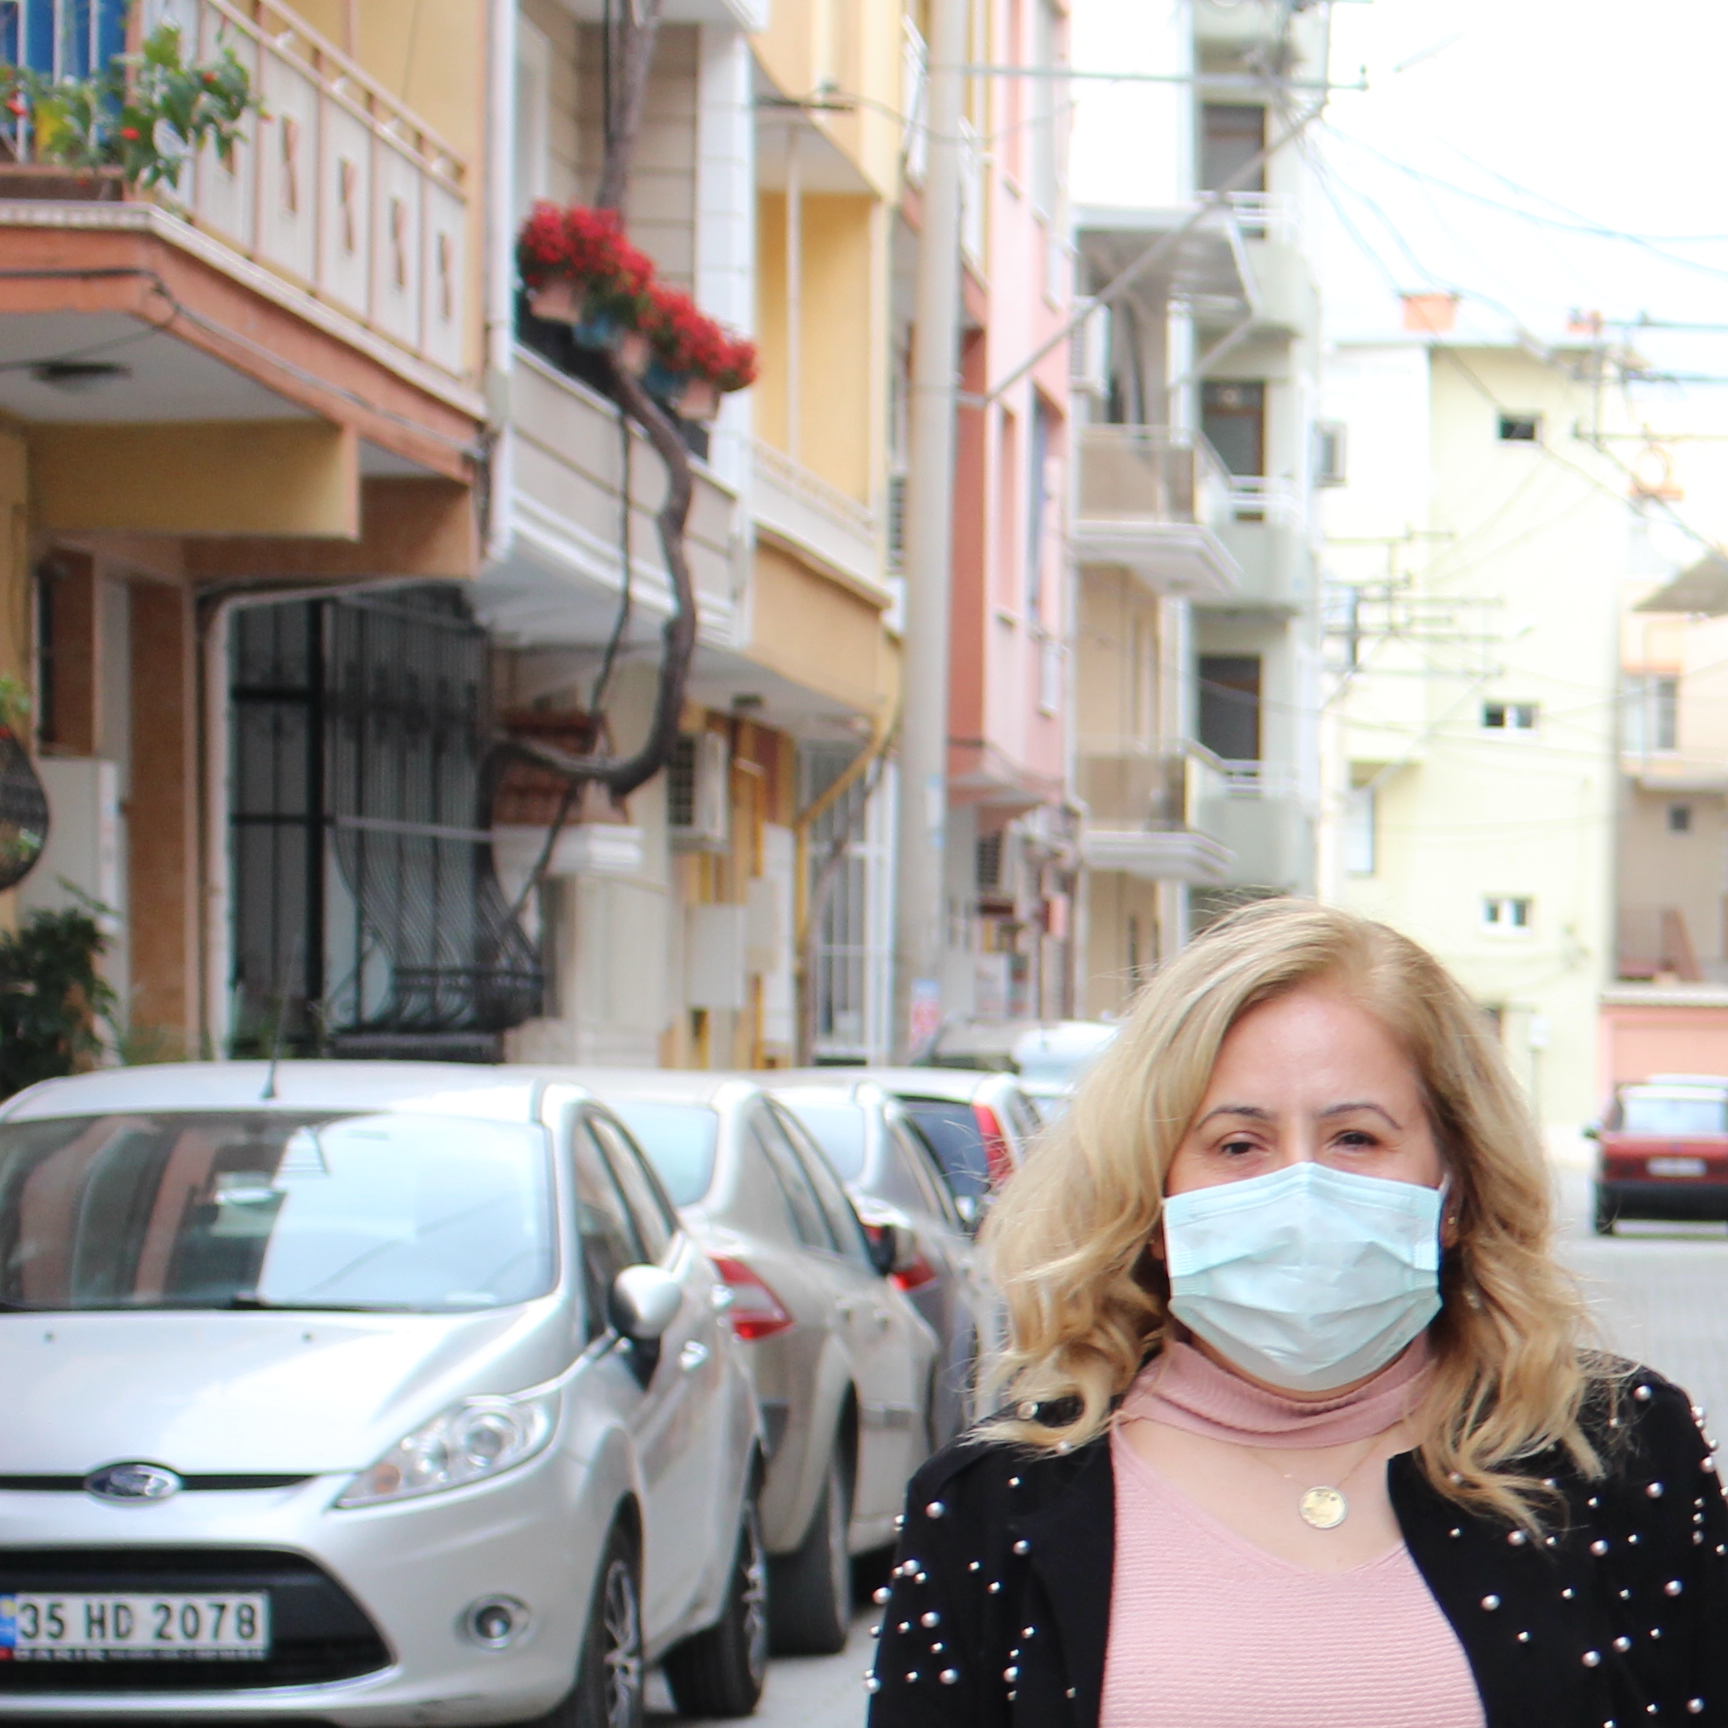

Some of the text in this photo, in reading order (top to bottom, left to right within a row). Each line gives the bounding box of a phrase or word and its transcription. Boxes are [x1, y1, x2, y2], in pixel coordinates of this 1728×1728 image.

[20, 1602, 256, 1641] 35 HD 2078
